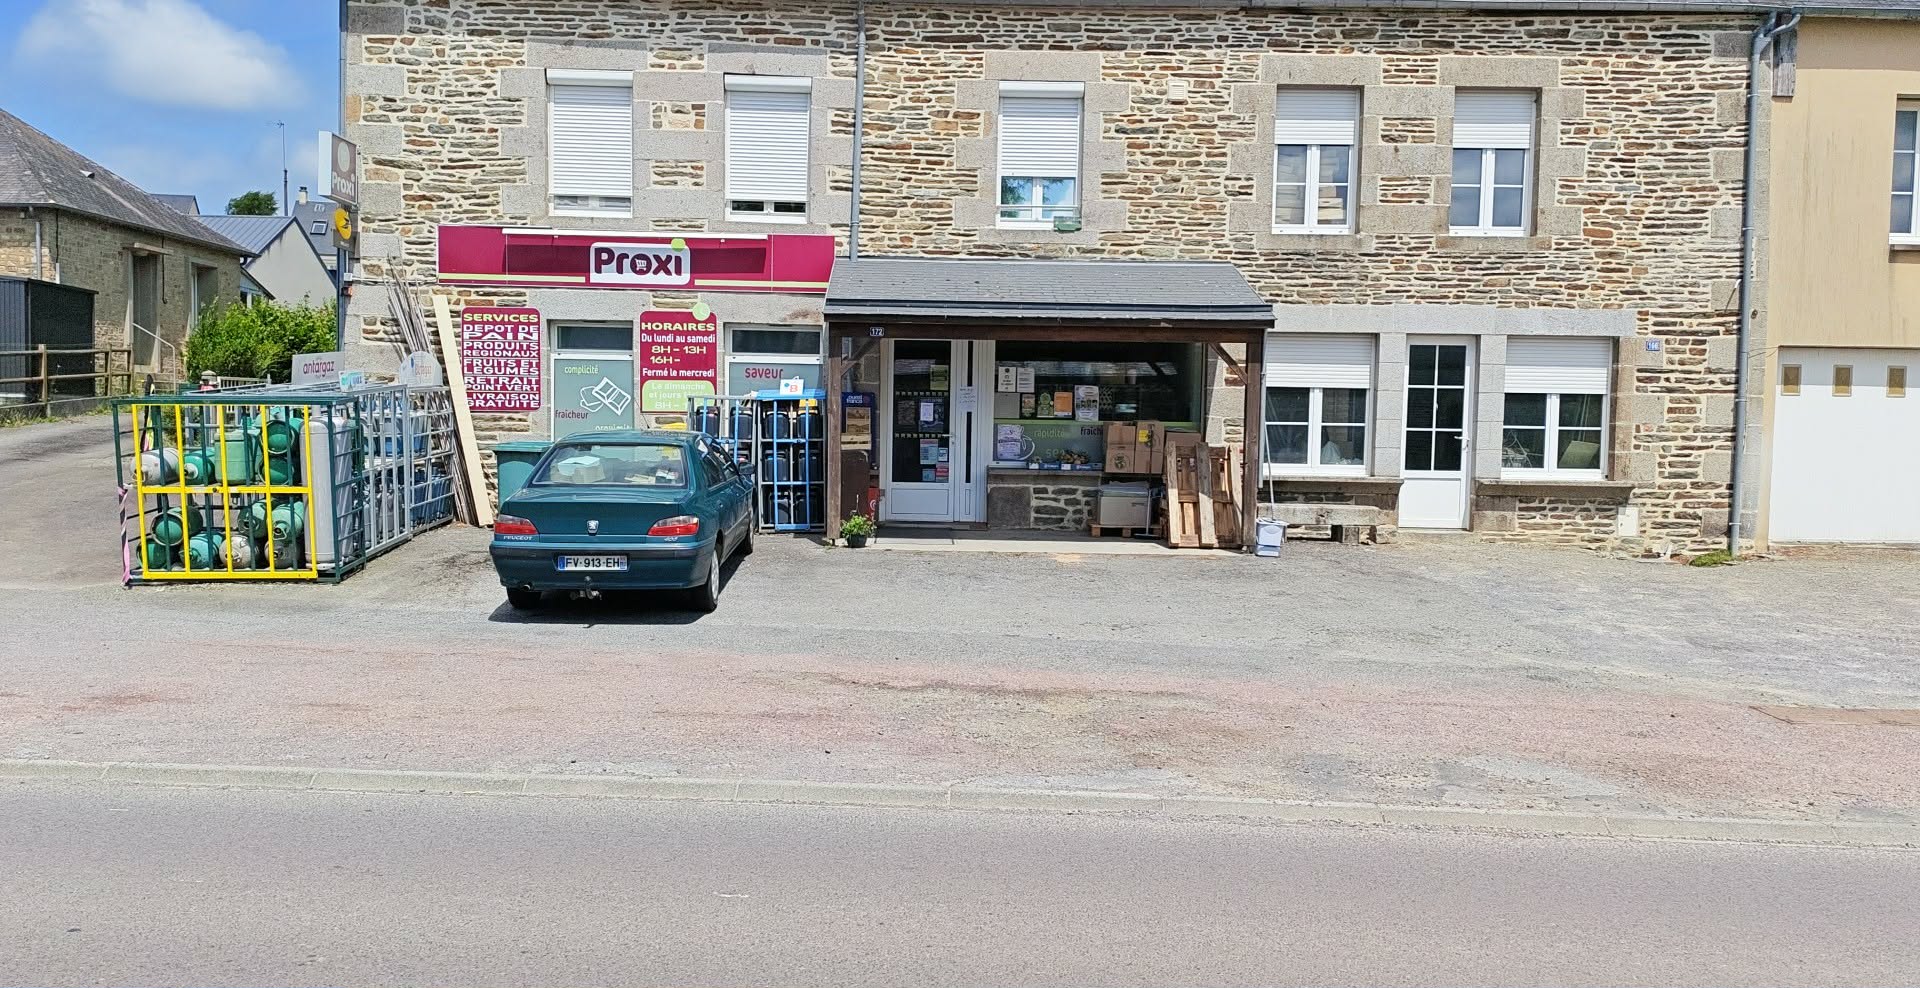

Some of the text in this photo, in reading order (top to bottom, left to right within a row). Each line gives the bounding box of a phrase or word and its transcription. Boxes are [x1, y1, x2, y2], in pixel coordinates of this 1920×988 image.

[331, 171, 355, 197] Proxi
[594, 239, 684, 277] Proxi
[463, 313, 539, 322] SERVICES
[463, 324, 539, 333] DEPOT DE
[641, 322, 715, 331] HORAIRES
[463, 331, 539, 340] PAIN
[641, 333, 652, 342] Du
[654, 333, 674, 343] lundi
[687, 334, 715, 343] samedi
[463, 342, 539, 350] PRODUITS
[651, 345, 671, 354] 8H
[683, 346, 707, 354] 13H
[463, 359, 517, 367] FRUITS
[649, 356, 673, 364] 16H
[303, 360, 335, 376] antargaz
[463, 366, 539, 375] LEGUMES
[564, 365, 599, 375] complicité
[642, 368, 715, 377] Fermé le mercredi
[745, 367, 784, 379] saveur
[463, 376, 539, 385] RETRAIT
[665, 382, 706, 390] dimanche
[467, 400, 540, 408] GRATUITE
